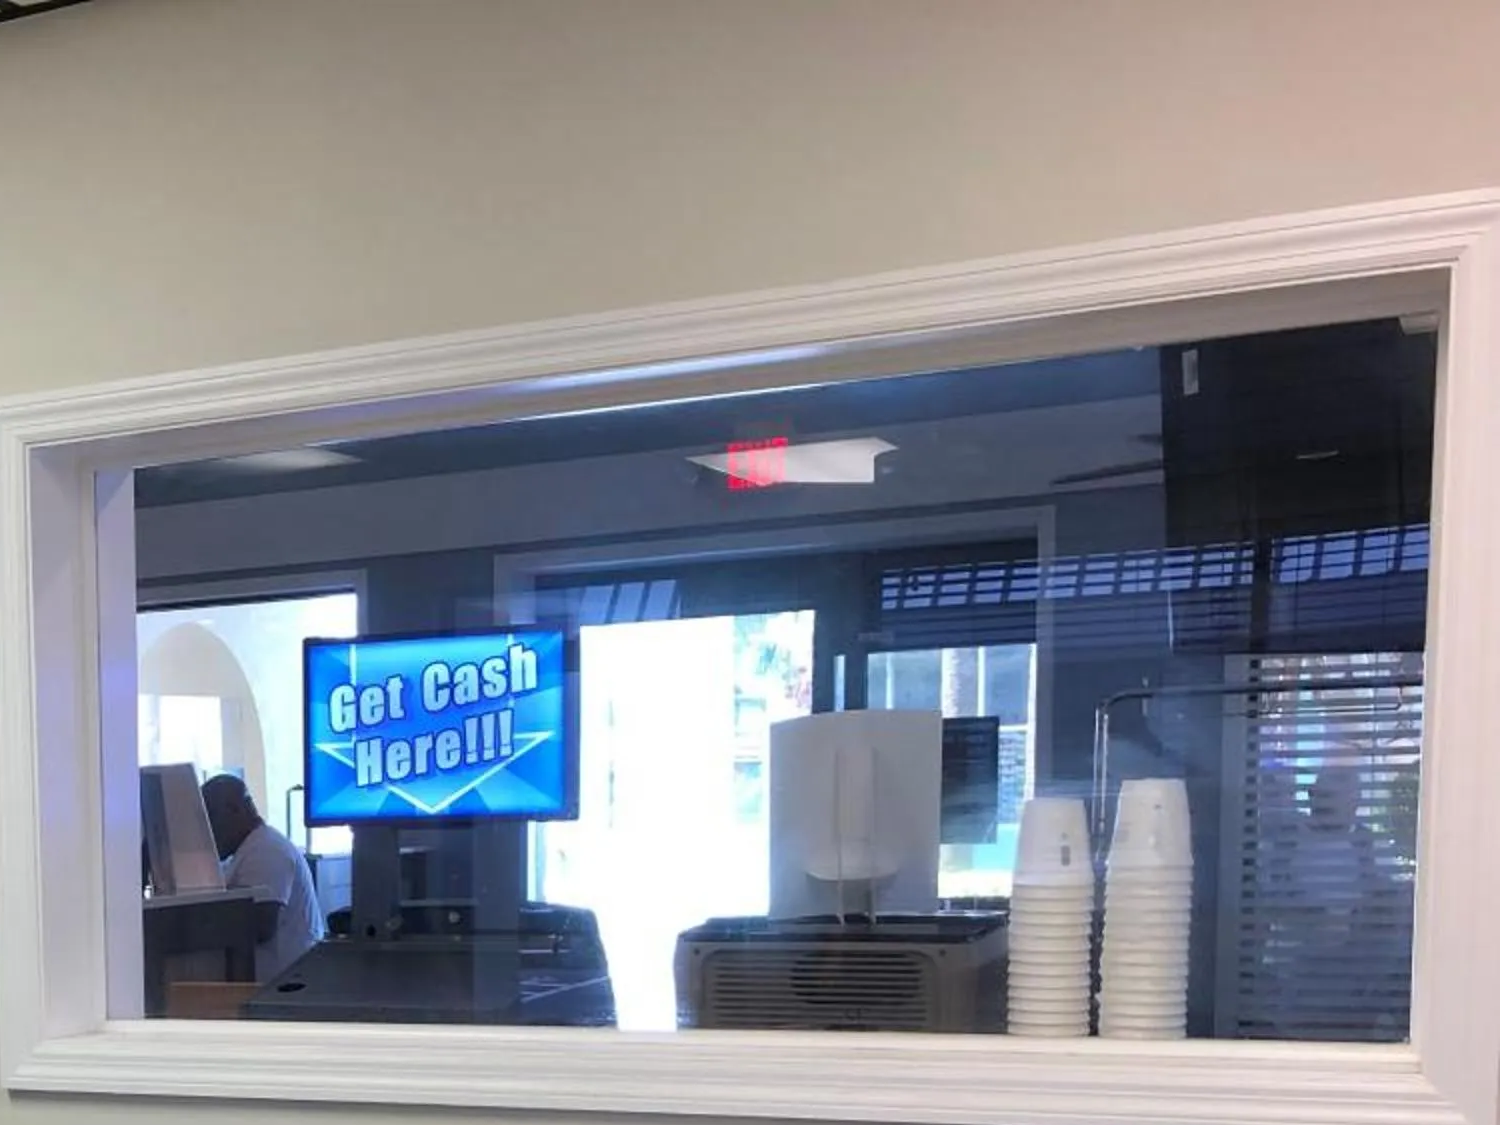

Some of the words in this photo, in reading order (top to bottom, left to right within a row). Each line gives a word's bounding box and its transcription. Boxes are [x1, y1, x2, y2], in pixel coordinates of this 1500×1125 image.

[328, 674, 405, 734] Get
[421, 641, 538, 713] Cash
[354, 708, 514, 788] Here!!!
